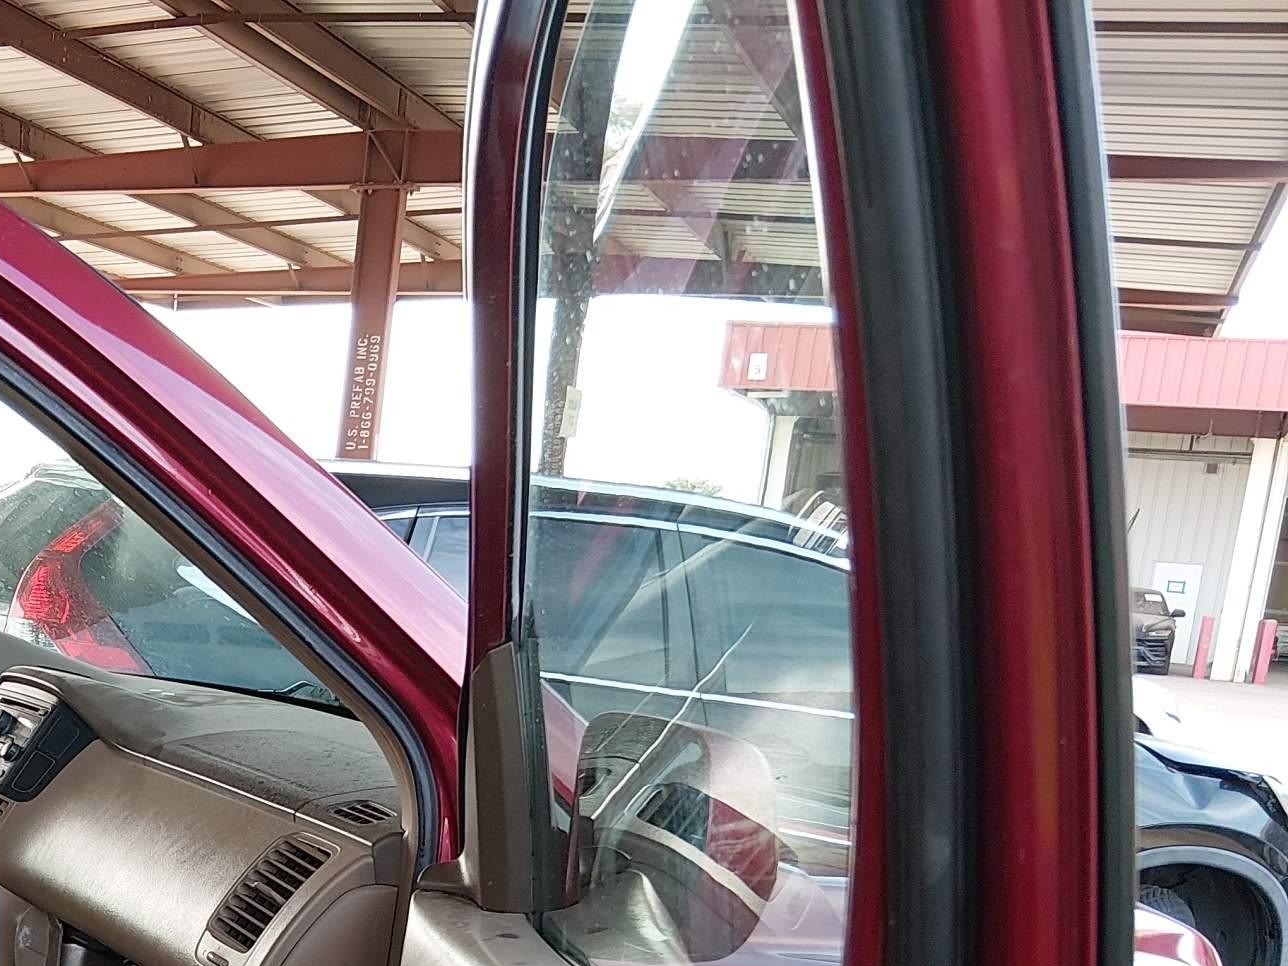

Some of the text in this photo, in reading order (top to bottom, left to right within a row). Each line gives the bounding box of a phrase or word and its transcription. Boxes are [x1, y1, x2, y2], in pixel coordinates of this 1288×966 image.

[345, 334, 369, 450] U.S. PREFAB INC.
